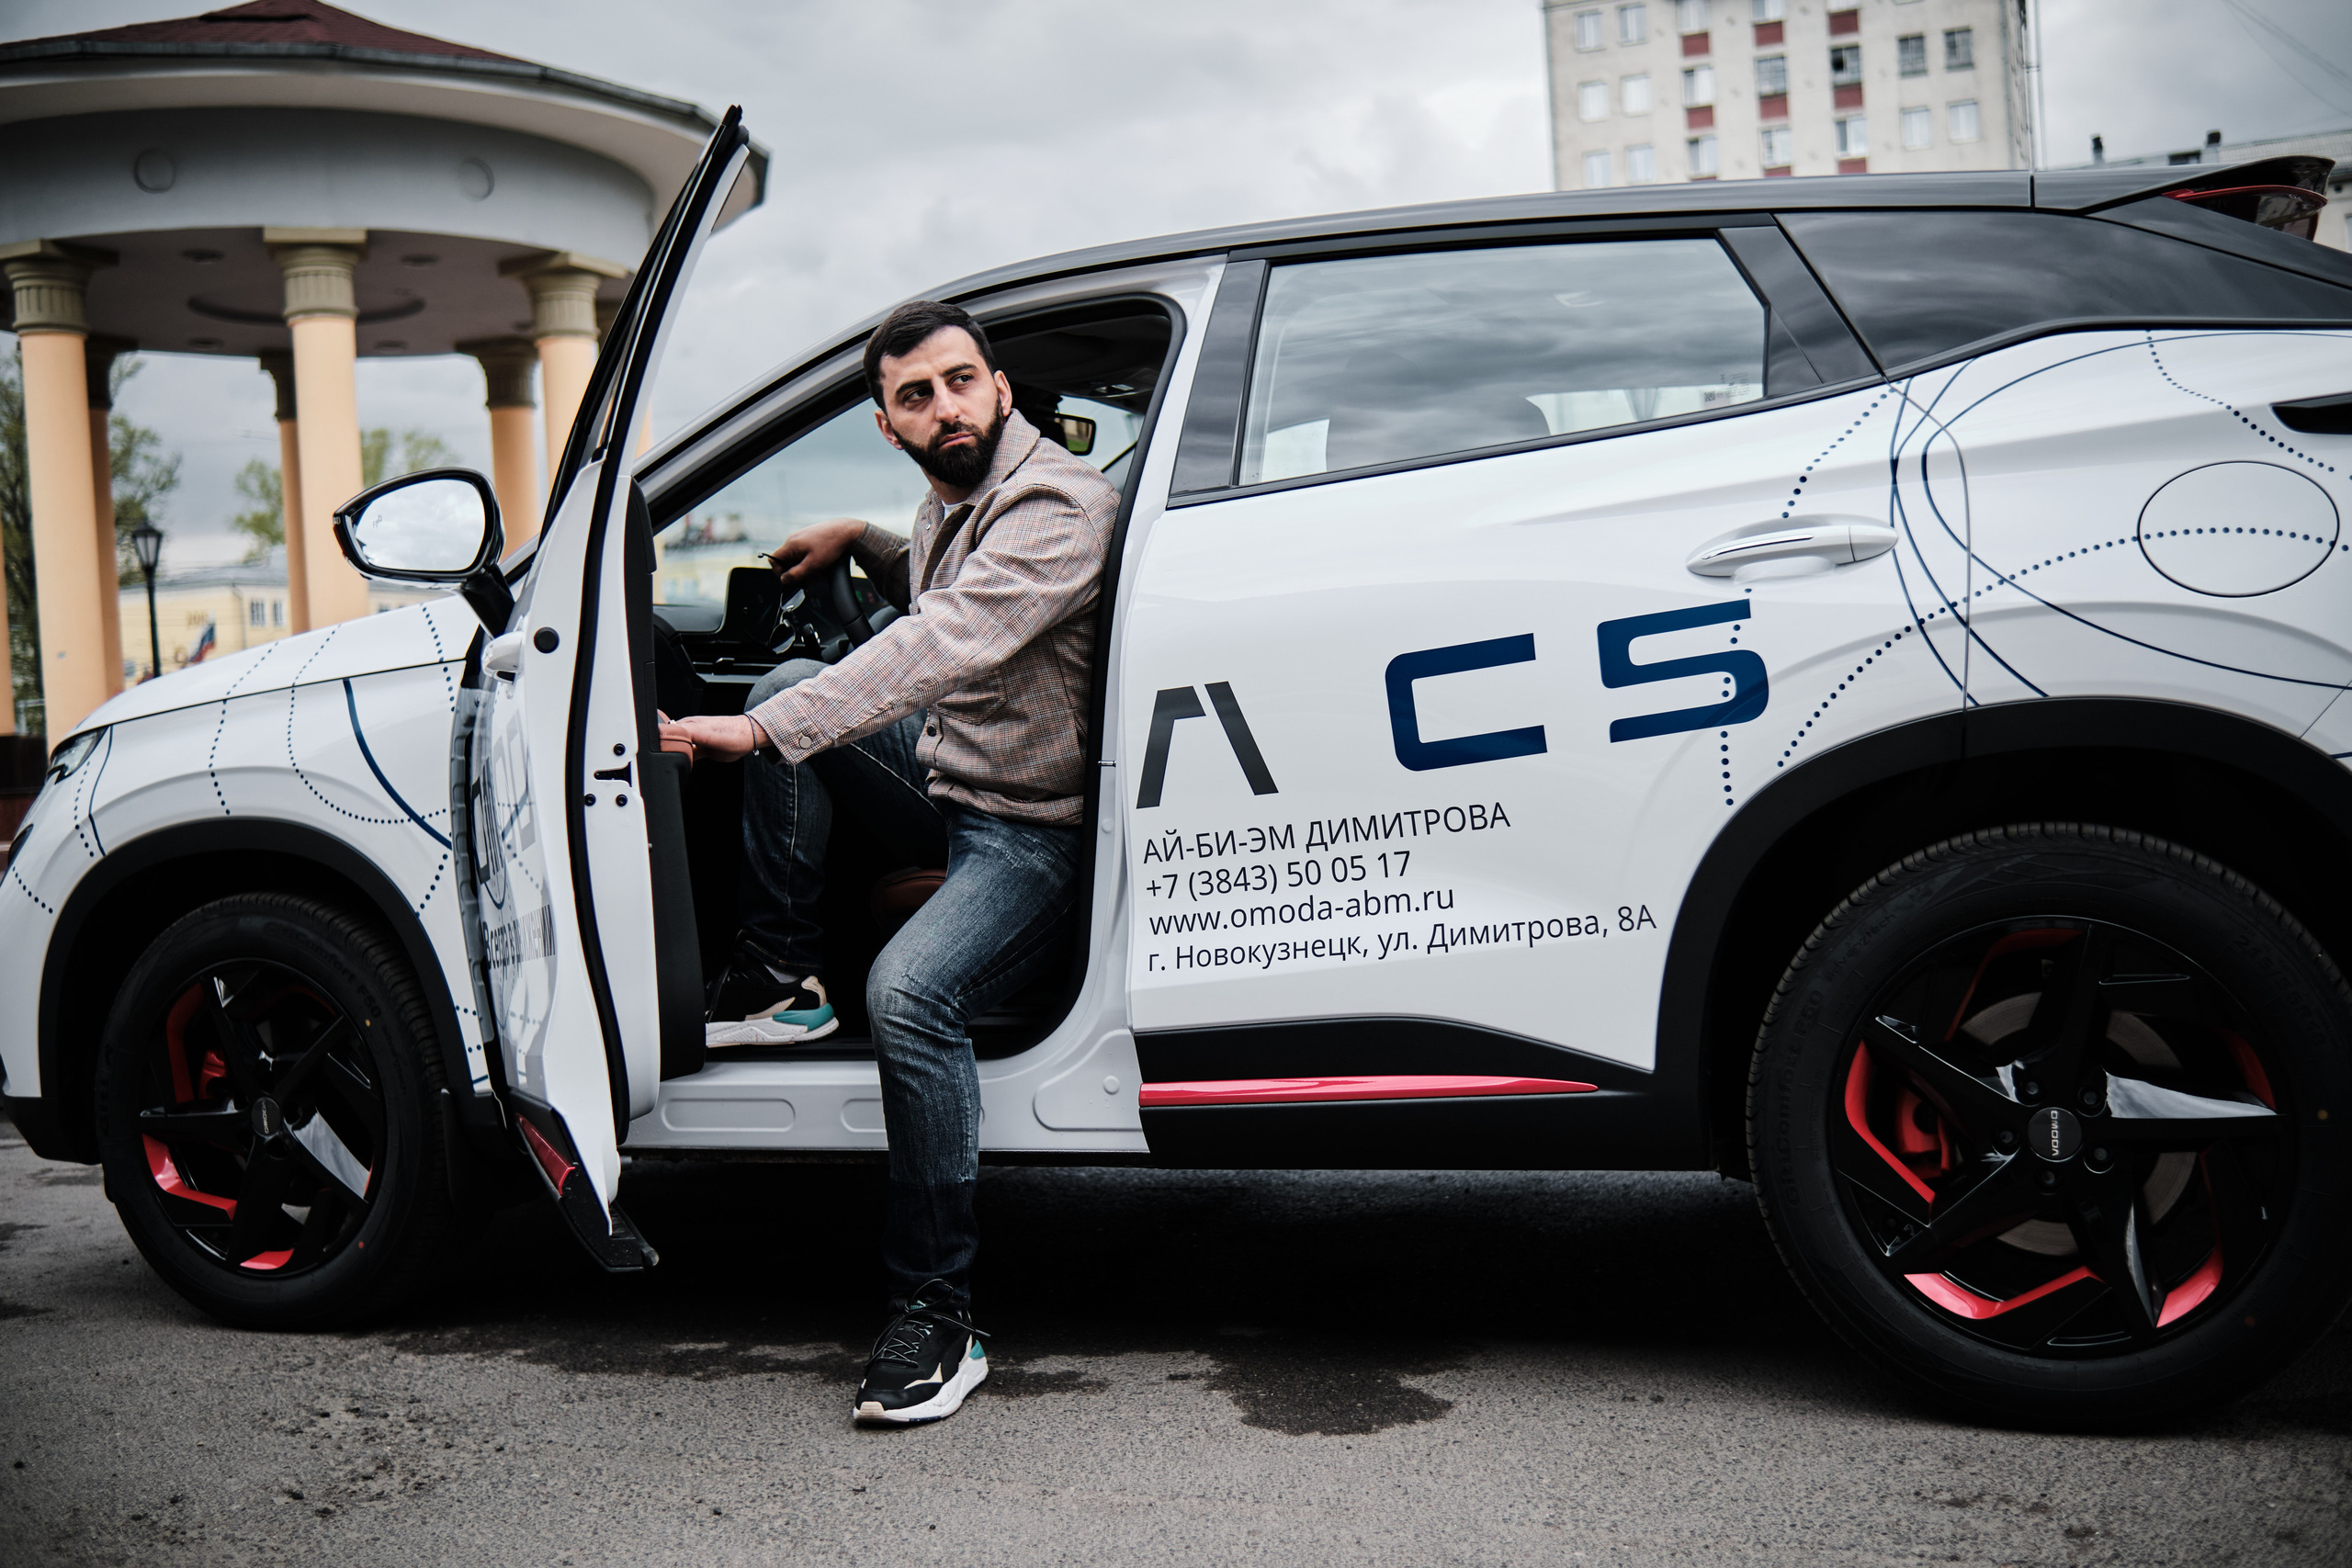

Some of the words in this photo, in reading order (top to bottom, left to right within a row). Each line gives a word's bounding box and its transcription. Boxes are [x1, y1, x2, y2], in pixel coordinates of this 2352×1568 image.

[1144, 823, 1295, 863] АЙ-БИ-ЭМ
[1306, 801, 1511, 854] ДИМИТРОВА
[1147, 874, 1178, 899] +7
[1189, 864, 1278, 902] (3843)
[1288, 859, 1322, 887] 50
[1331, 855, 1366, 883] 05
[1377, 850, 1411, 878] 17
[1149, 888, 1454, 936] www.omoda-abm.ru
[482, 921, 511, 980] Всегда
[1148, 948, 1166, 972] г.
[1175, 934, 1368, 970] Новокузнецк,
[1377, 931, 1419, 961] ул.
[1427, 916, 1609, 955] Димитрова,
[1775, 1043, 1804, 1207] GitiComfort
[1791, 990, 1824, 1039] F50
